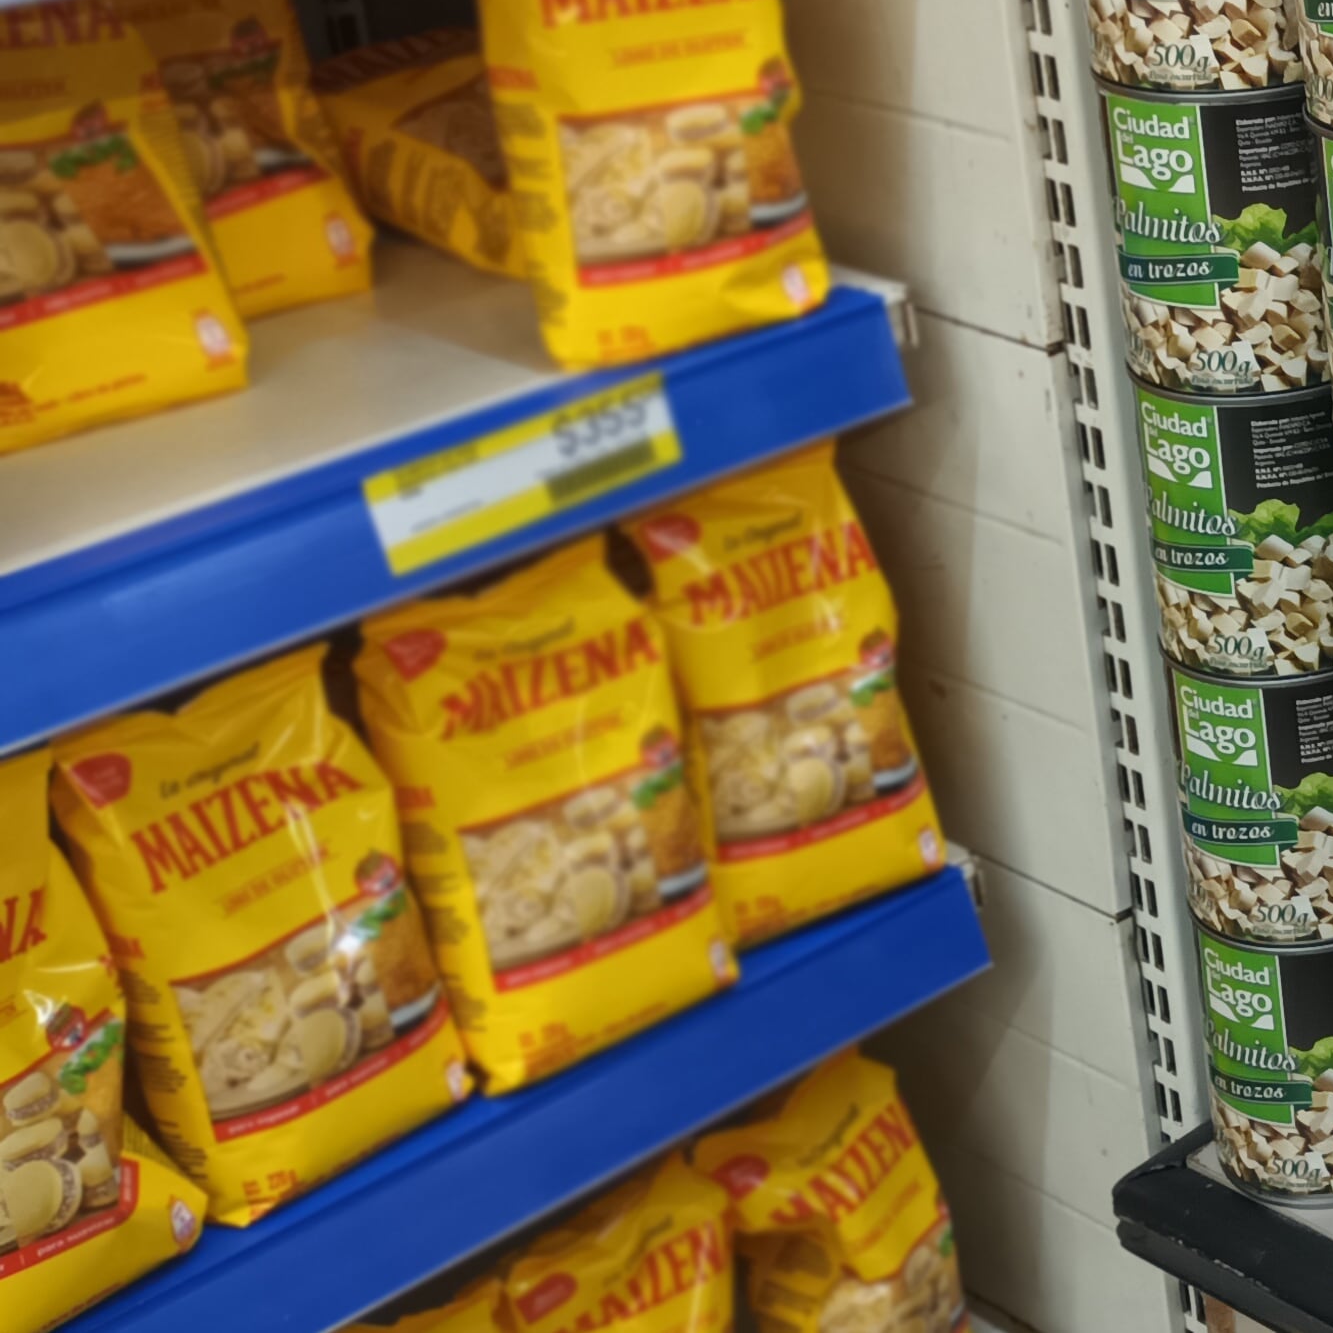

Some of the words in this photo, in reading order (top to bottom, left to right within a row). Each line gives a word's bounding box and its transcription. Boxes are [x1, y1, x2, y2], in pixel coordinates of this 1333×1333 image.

[683, 521, 880, 627] MAIZENA
[441, 619, 660, 741] MAIZENA
[130, 763, 362, 894] MAIZENA
